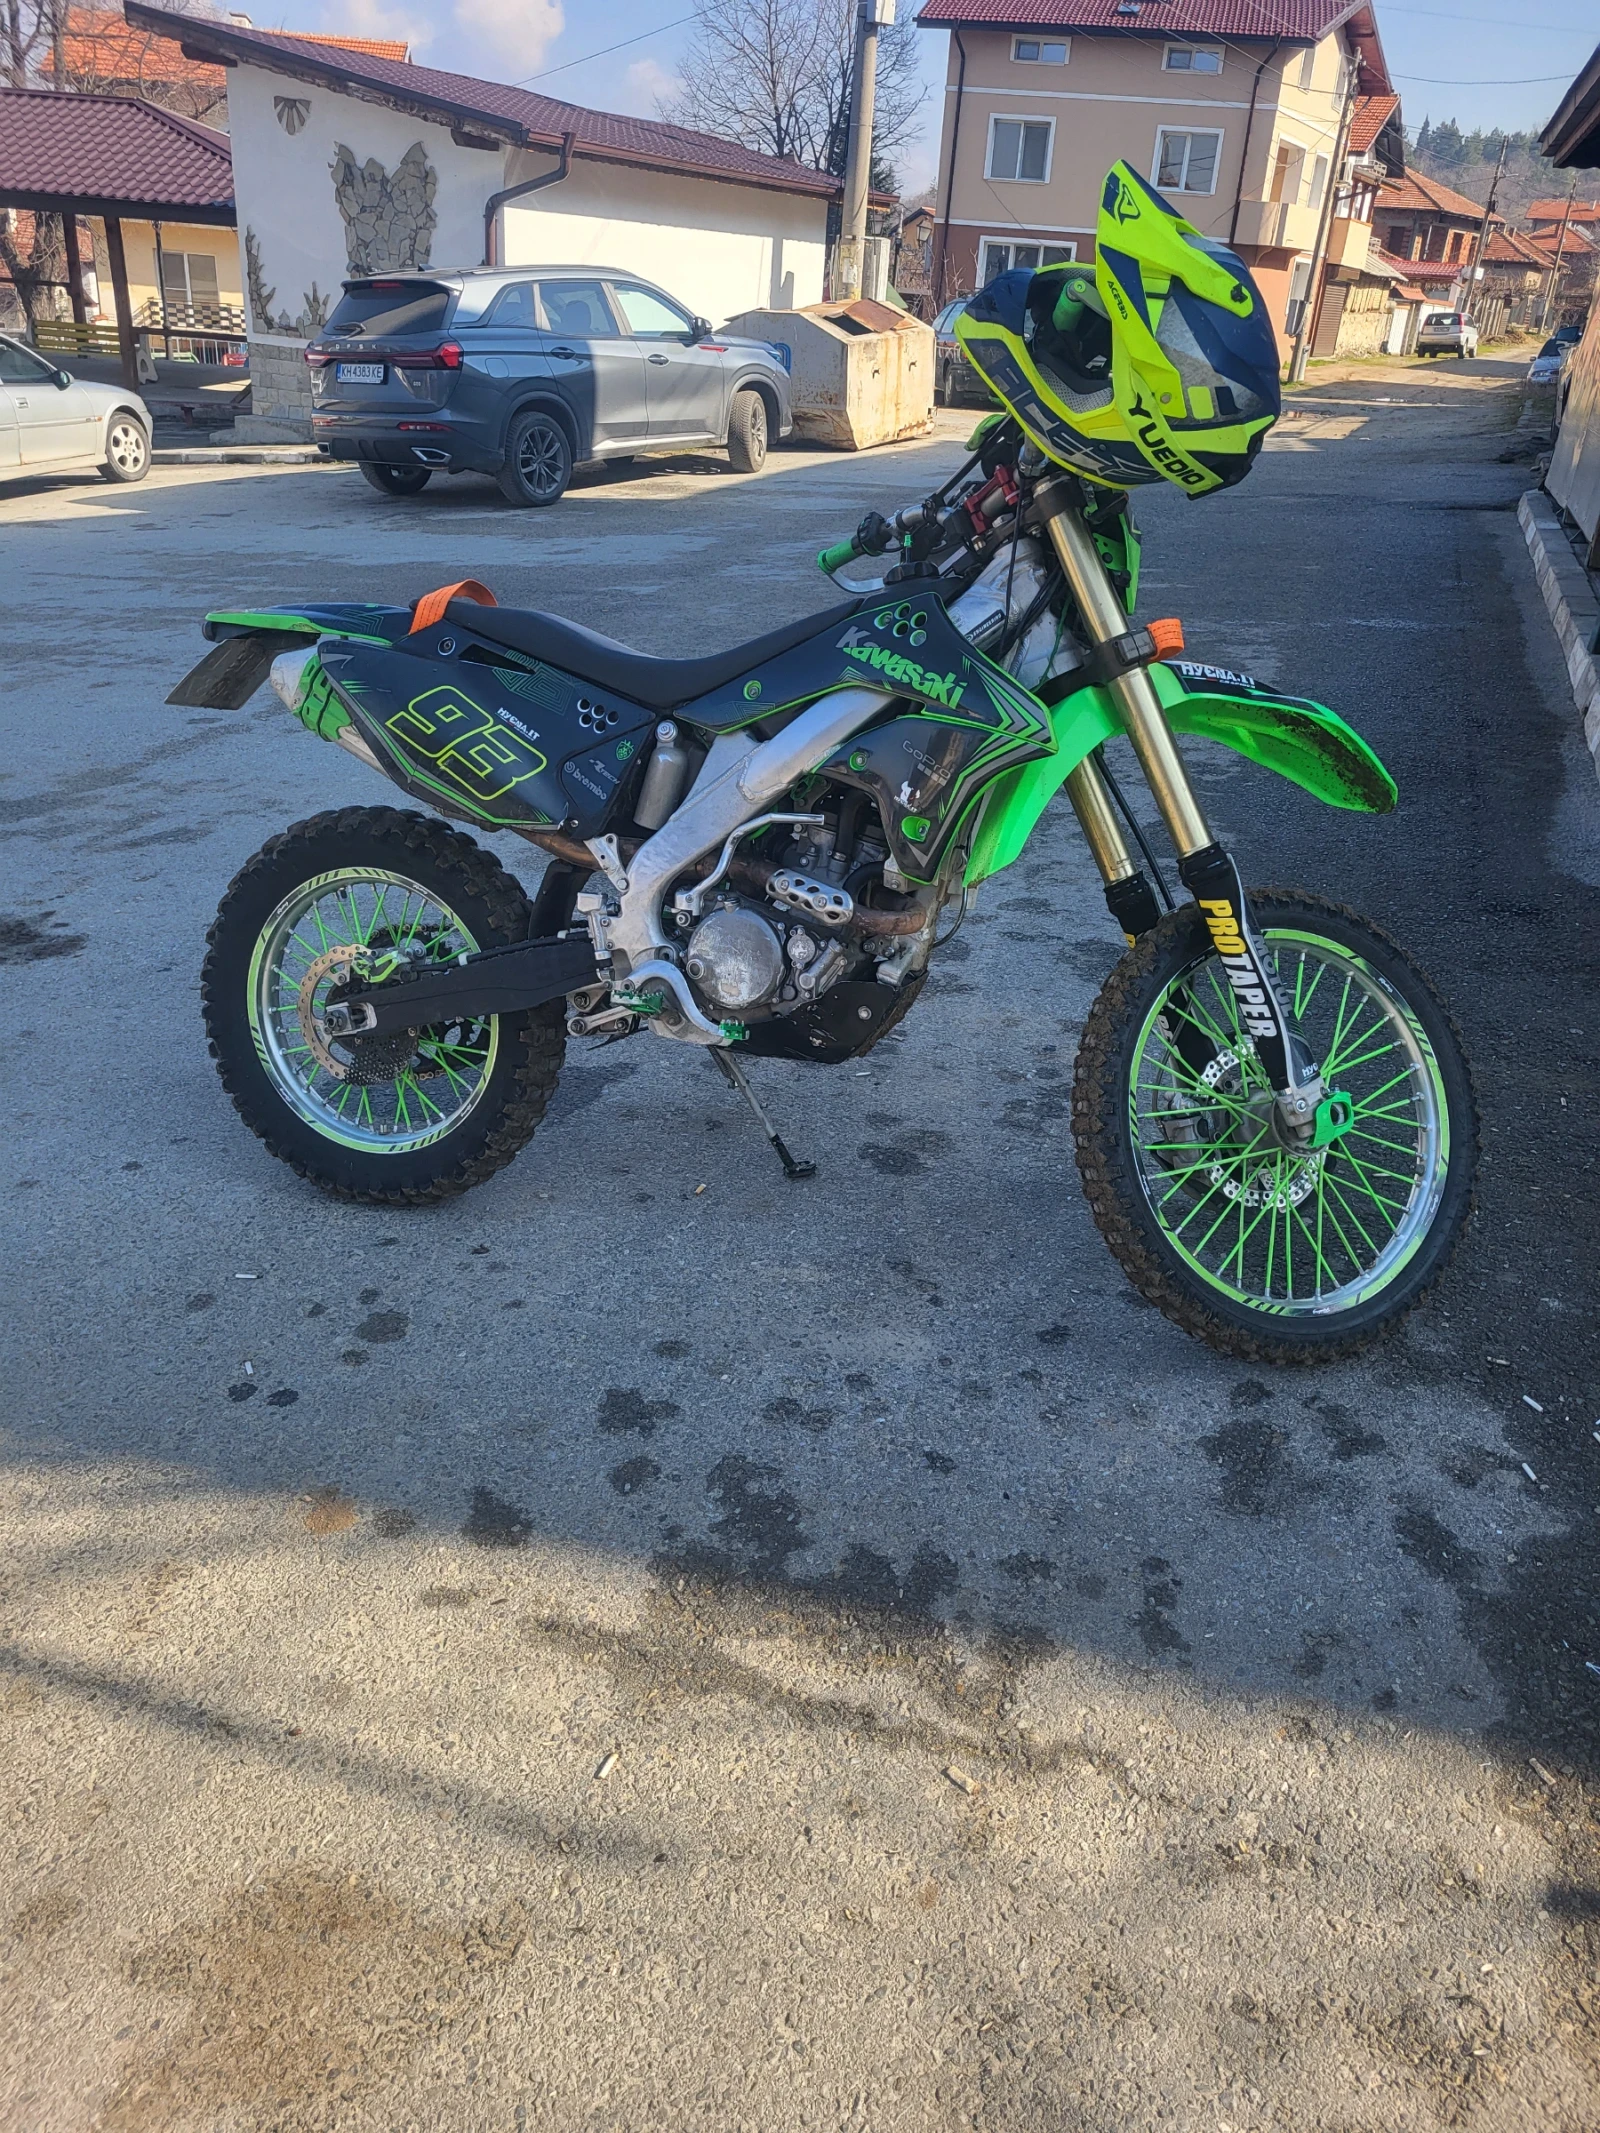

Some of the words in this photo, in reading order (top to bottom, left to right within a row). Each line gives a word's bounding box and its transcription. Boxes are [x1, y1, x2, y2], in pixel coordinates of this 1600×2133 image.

[1107, 280, 1128, 320] ACERBIS
[835, 625, 968, 710] Kawasaki
[572, 768, 607, 801] brembo
[1250, 934, 1295, 1018] MOTUL
